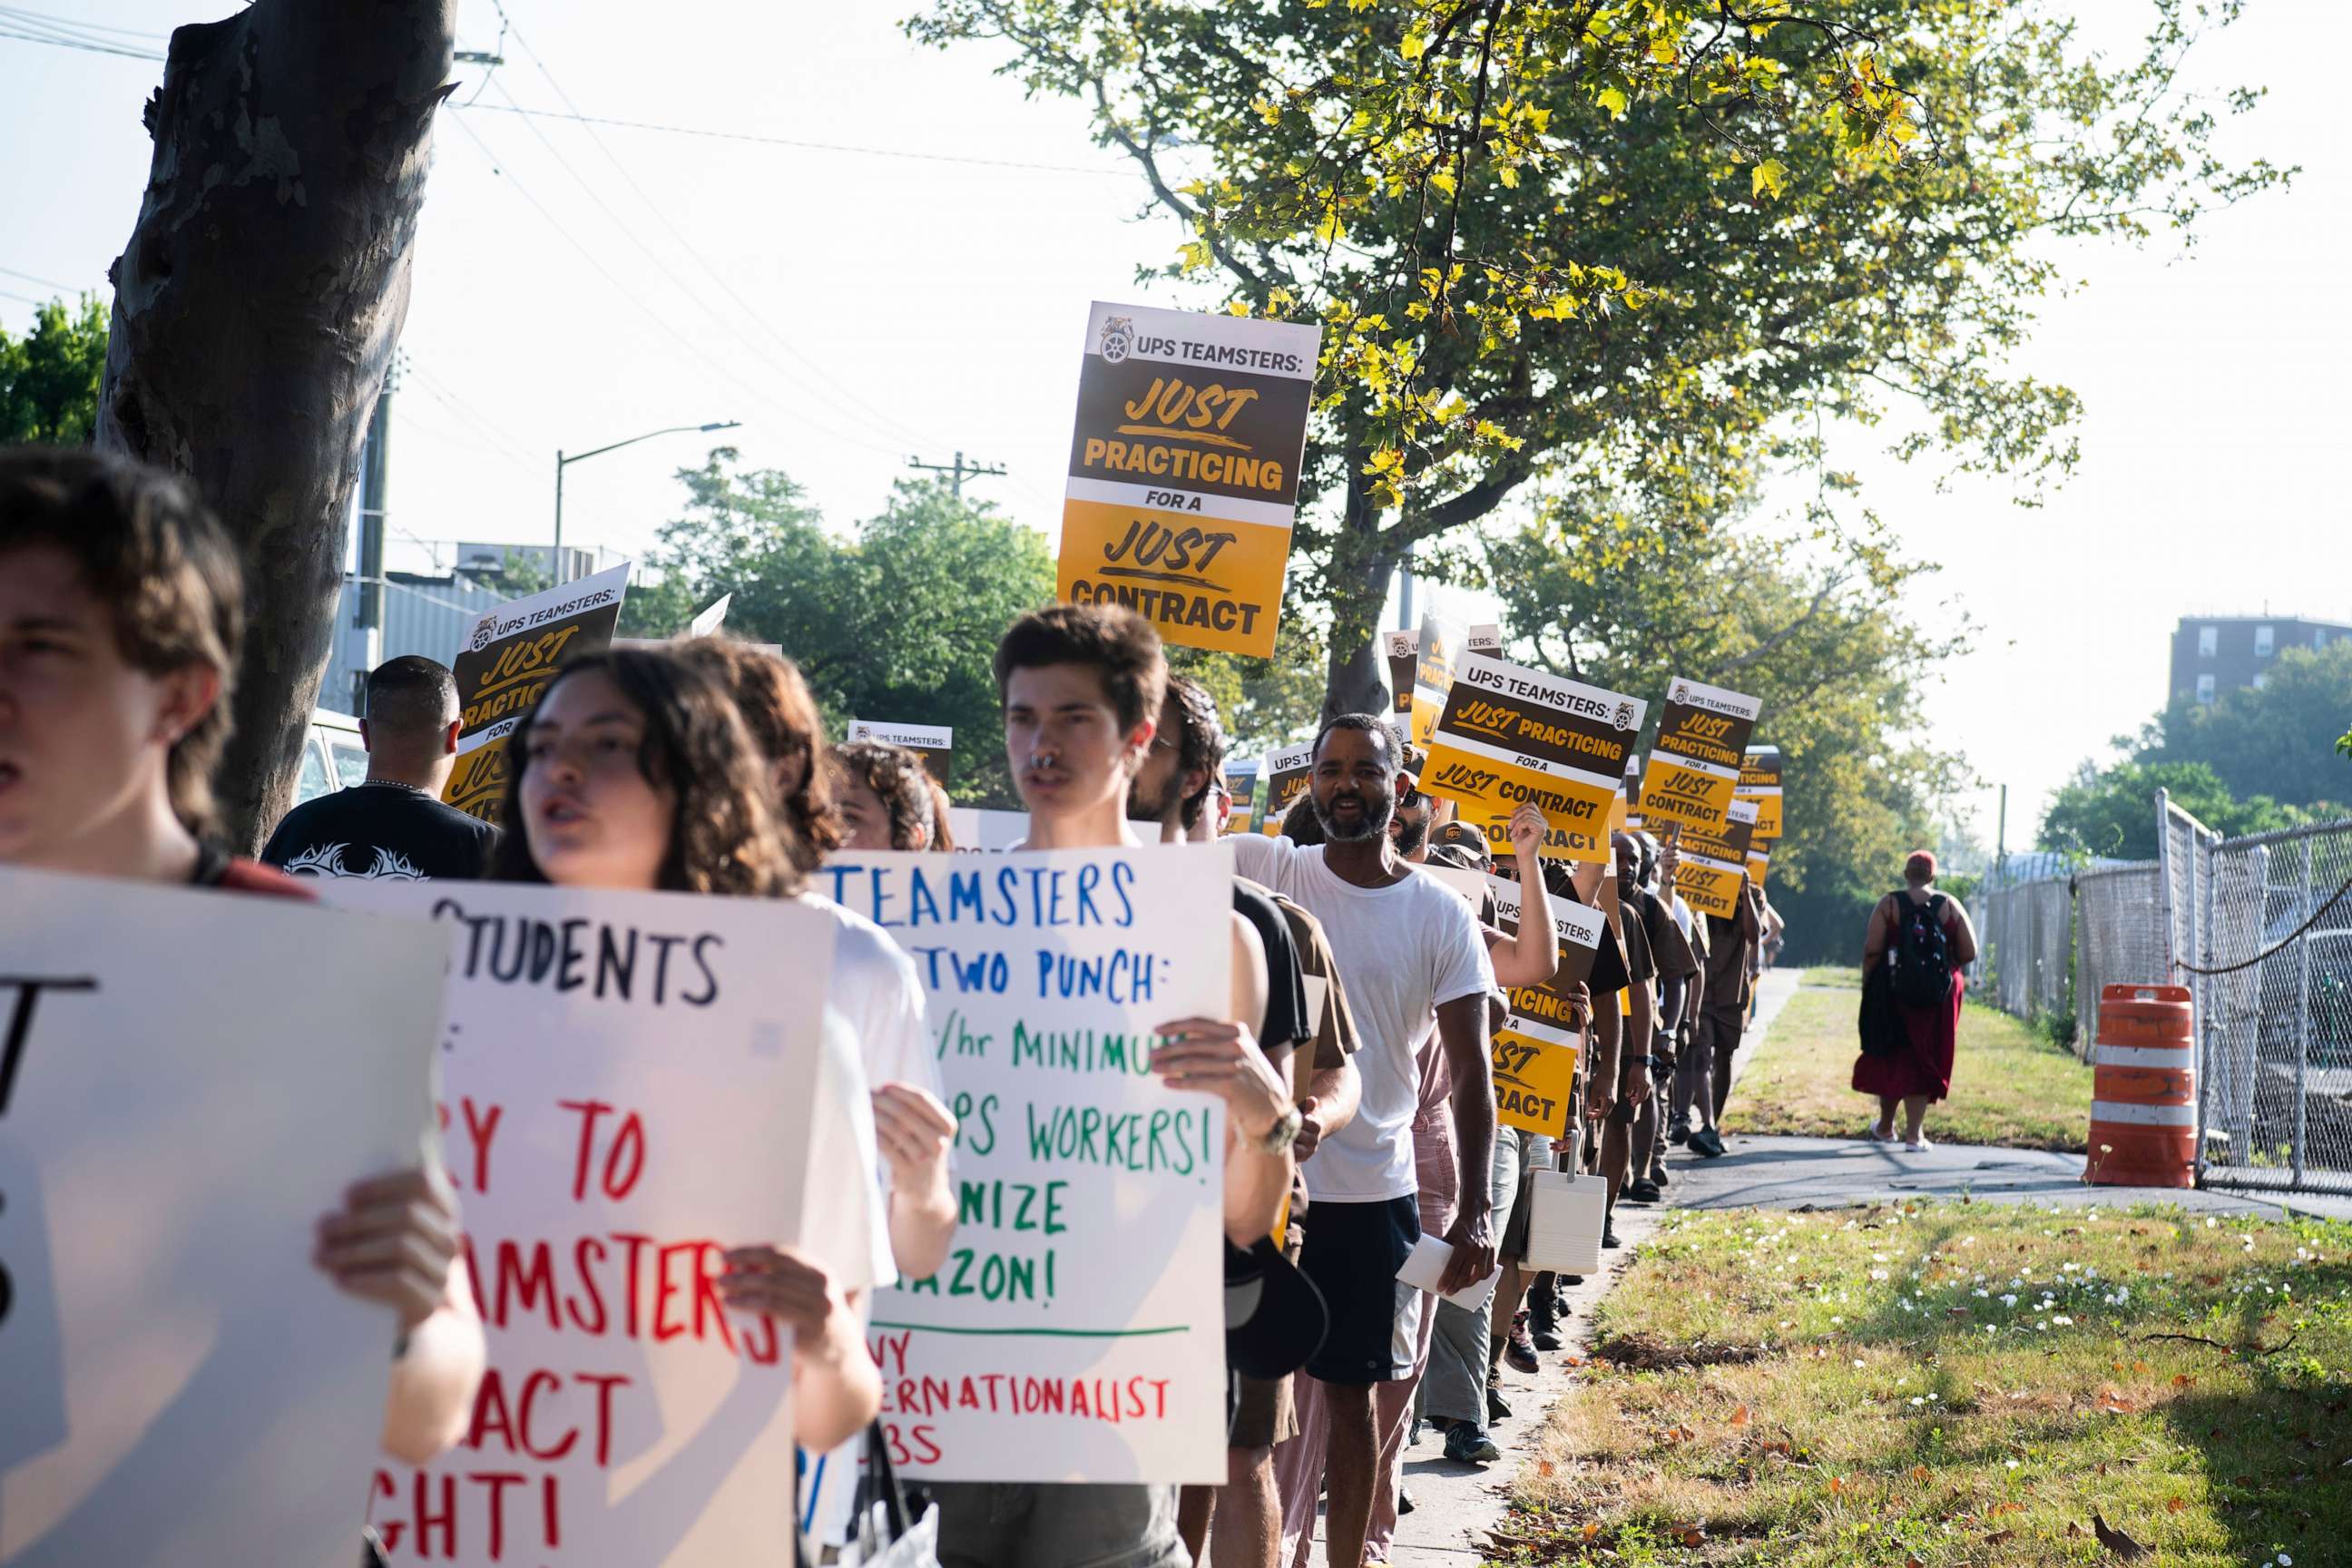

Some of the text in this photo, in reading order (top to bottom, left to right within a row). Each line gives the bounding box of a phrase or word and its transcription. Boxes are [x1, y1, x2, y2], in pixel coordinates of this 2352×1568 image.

[1137, 336, 1304, 374] UPS TEAMSTERS:
[1124, 377, 1259, 431] JUST
[1083, 438, 1284, 492] PRACTICING
[1145, 490, 1202, 512] FOR A
[1103, 520, 1237, 573] JUST
[497, 589, 616, 636] UPS TEAMSTERS:
[1070, 580, 1261, 635] CONTRACT
[481, 624, 580, 686] JUST
[1467, 667, 1612, 720] UPS TEAMSTERS:
[1689, 694, 1752, 718] UPS TEAMSTERS:
[486, 721, 514, 741] FOR
[892, 735, 946, 747] TEAMSTERS:
[1455, 700, 1521, 730] JUST
[1517, 719, 1624, 761] PRACTICING
[1681, 712, 1734, 739] JUST
[1274, 755, 1301, 770] UPS
[1515, 756, 1548, 771] FOR A
[1660, 735, 1739, 766] PRACTICING
[1684, 760, 1701, 769] FOR
[1436, 762, 1598, 820] JUST CONTRACT
[1663, 771, 1718, 797] JUST
[1646, 794, 1721, 823] CONTRACT
[820, 860, 1136, 930] TEAMSTERS
[1496, 900, 1594, 944] UPS STERS:
[910, 946, 1171, 1005] TWO PUNCH:
[1011, 1018, 1186, 1077] MINIMU
[557, 1098, 650, 1204] TO
[1025, 1101, 1210, 1186] WORKERS!
